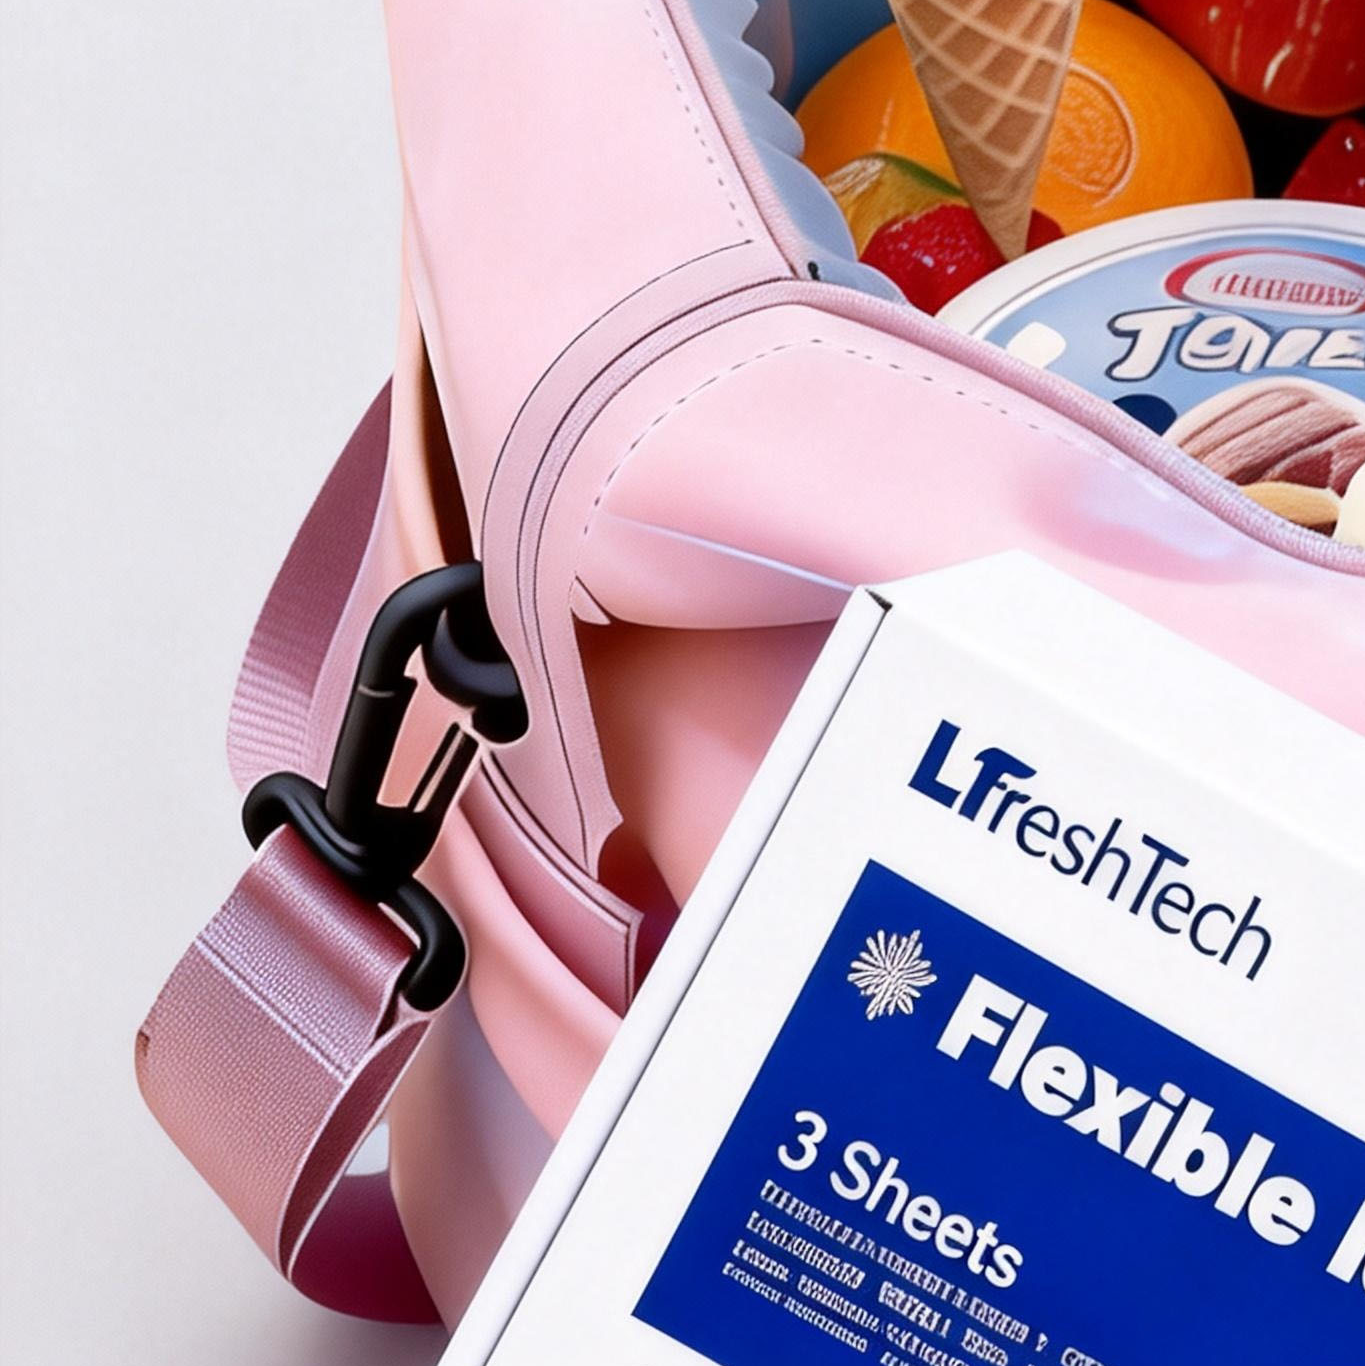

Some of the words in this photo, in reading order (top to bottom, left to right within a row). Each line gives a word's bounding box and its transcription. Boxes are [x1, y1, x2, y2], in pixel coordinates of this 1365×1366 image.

[778, 1111, 828, 1172] 3
[829, 1141, 1024, 1288] Sheets
[936, 973, 1316, 1246] Flexible
